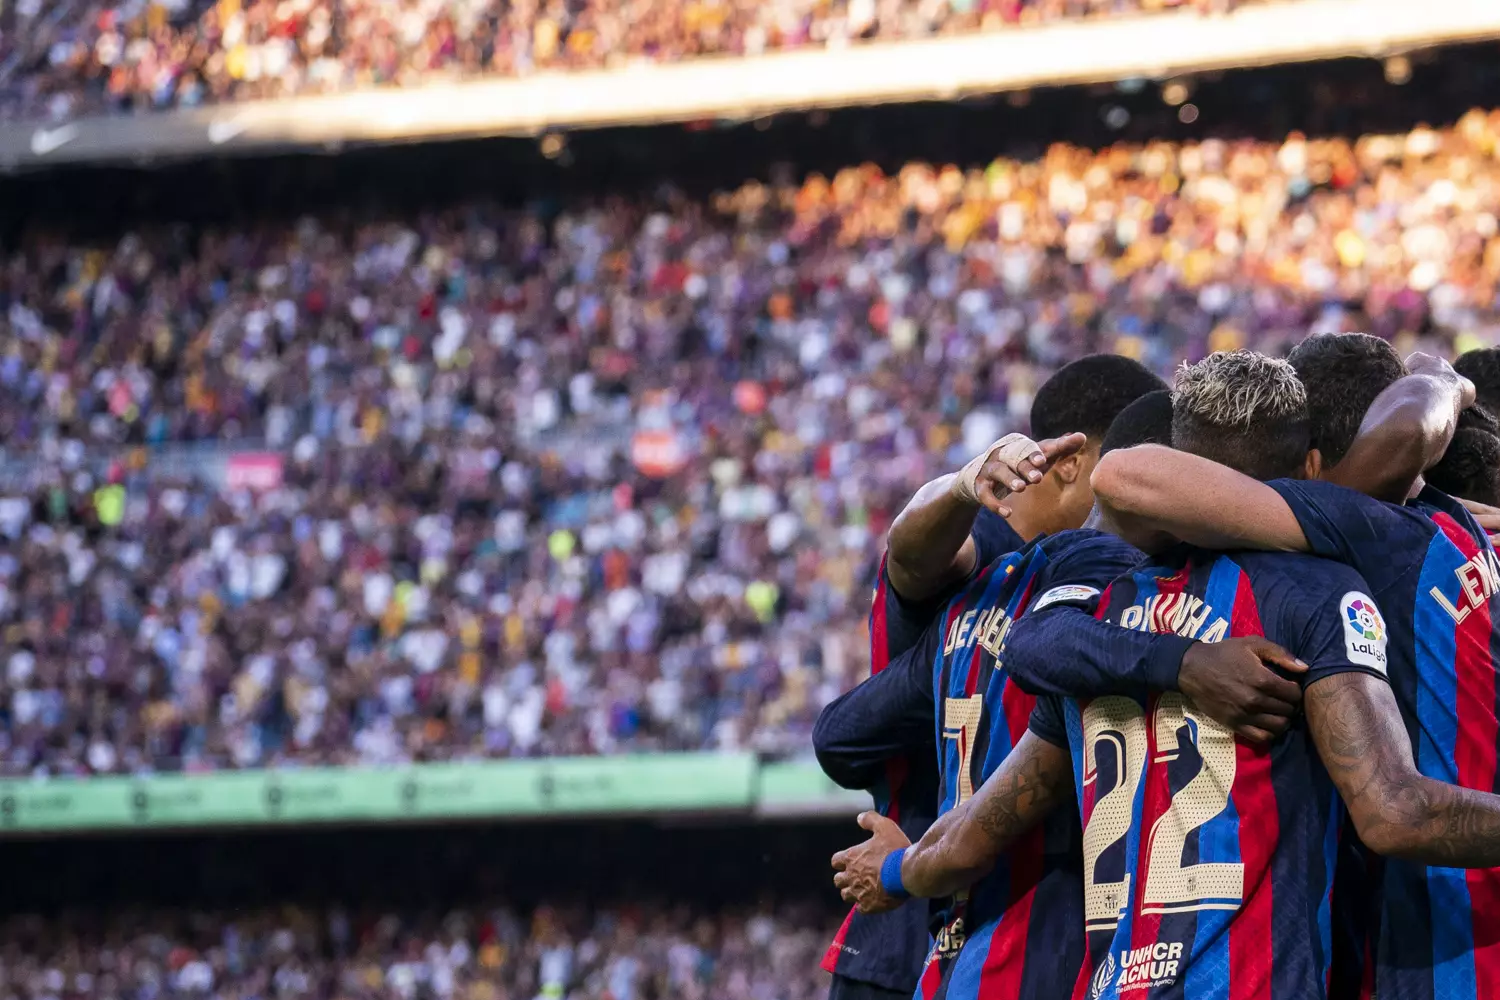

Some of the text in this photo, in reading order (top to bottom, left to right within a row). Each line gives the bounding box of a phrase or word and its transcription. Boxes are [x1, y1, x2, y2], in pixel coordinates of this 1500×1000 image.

[1351, 642, 1386, 662] LaLiga
[943, 694, 982, 809] 7
[1082, 691, 1245, 931] 22
[1120, 942, 1184, 968] UNHCR
[1116, 960, 1179, 987] ACNUR
